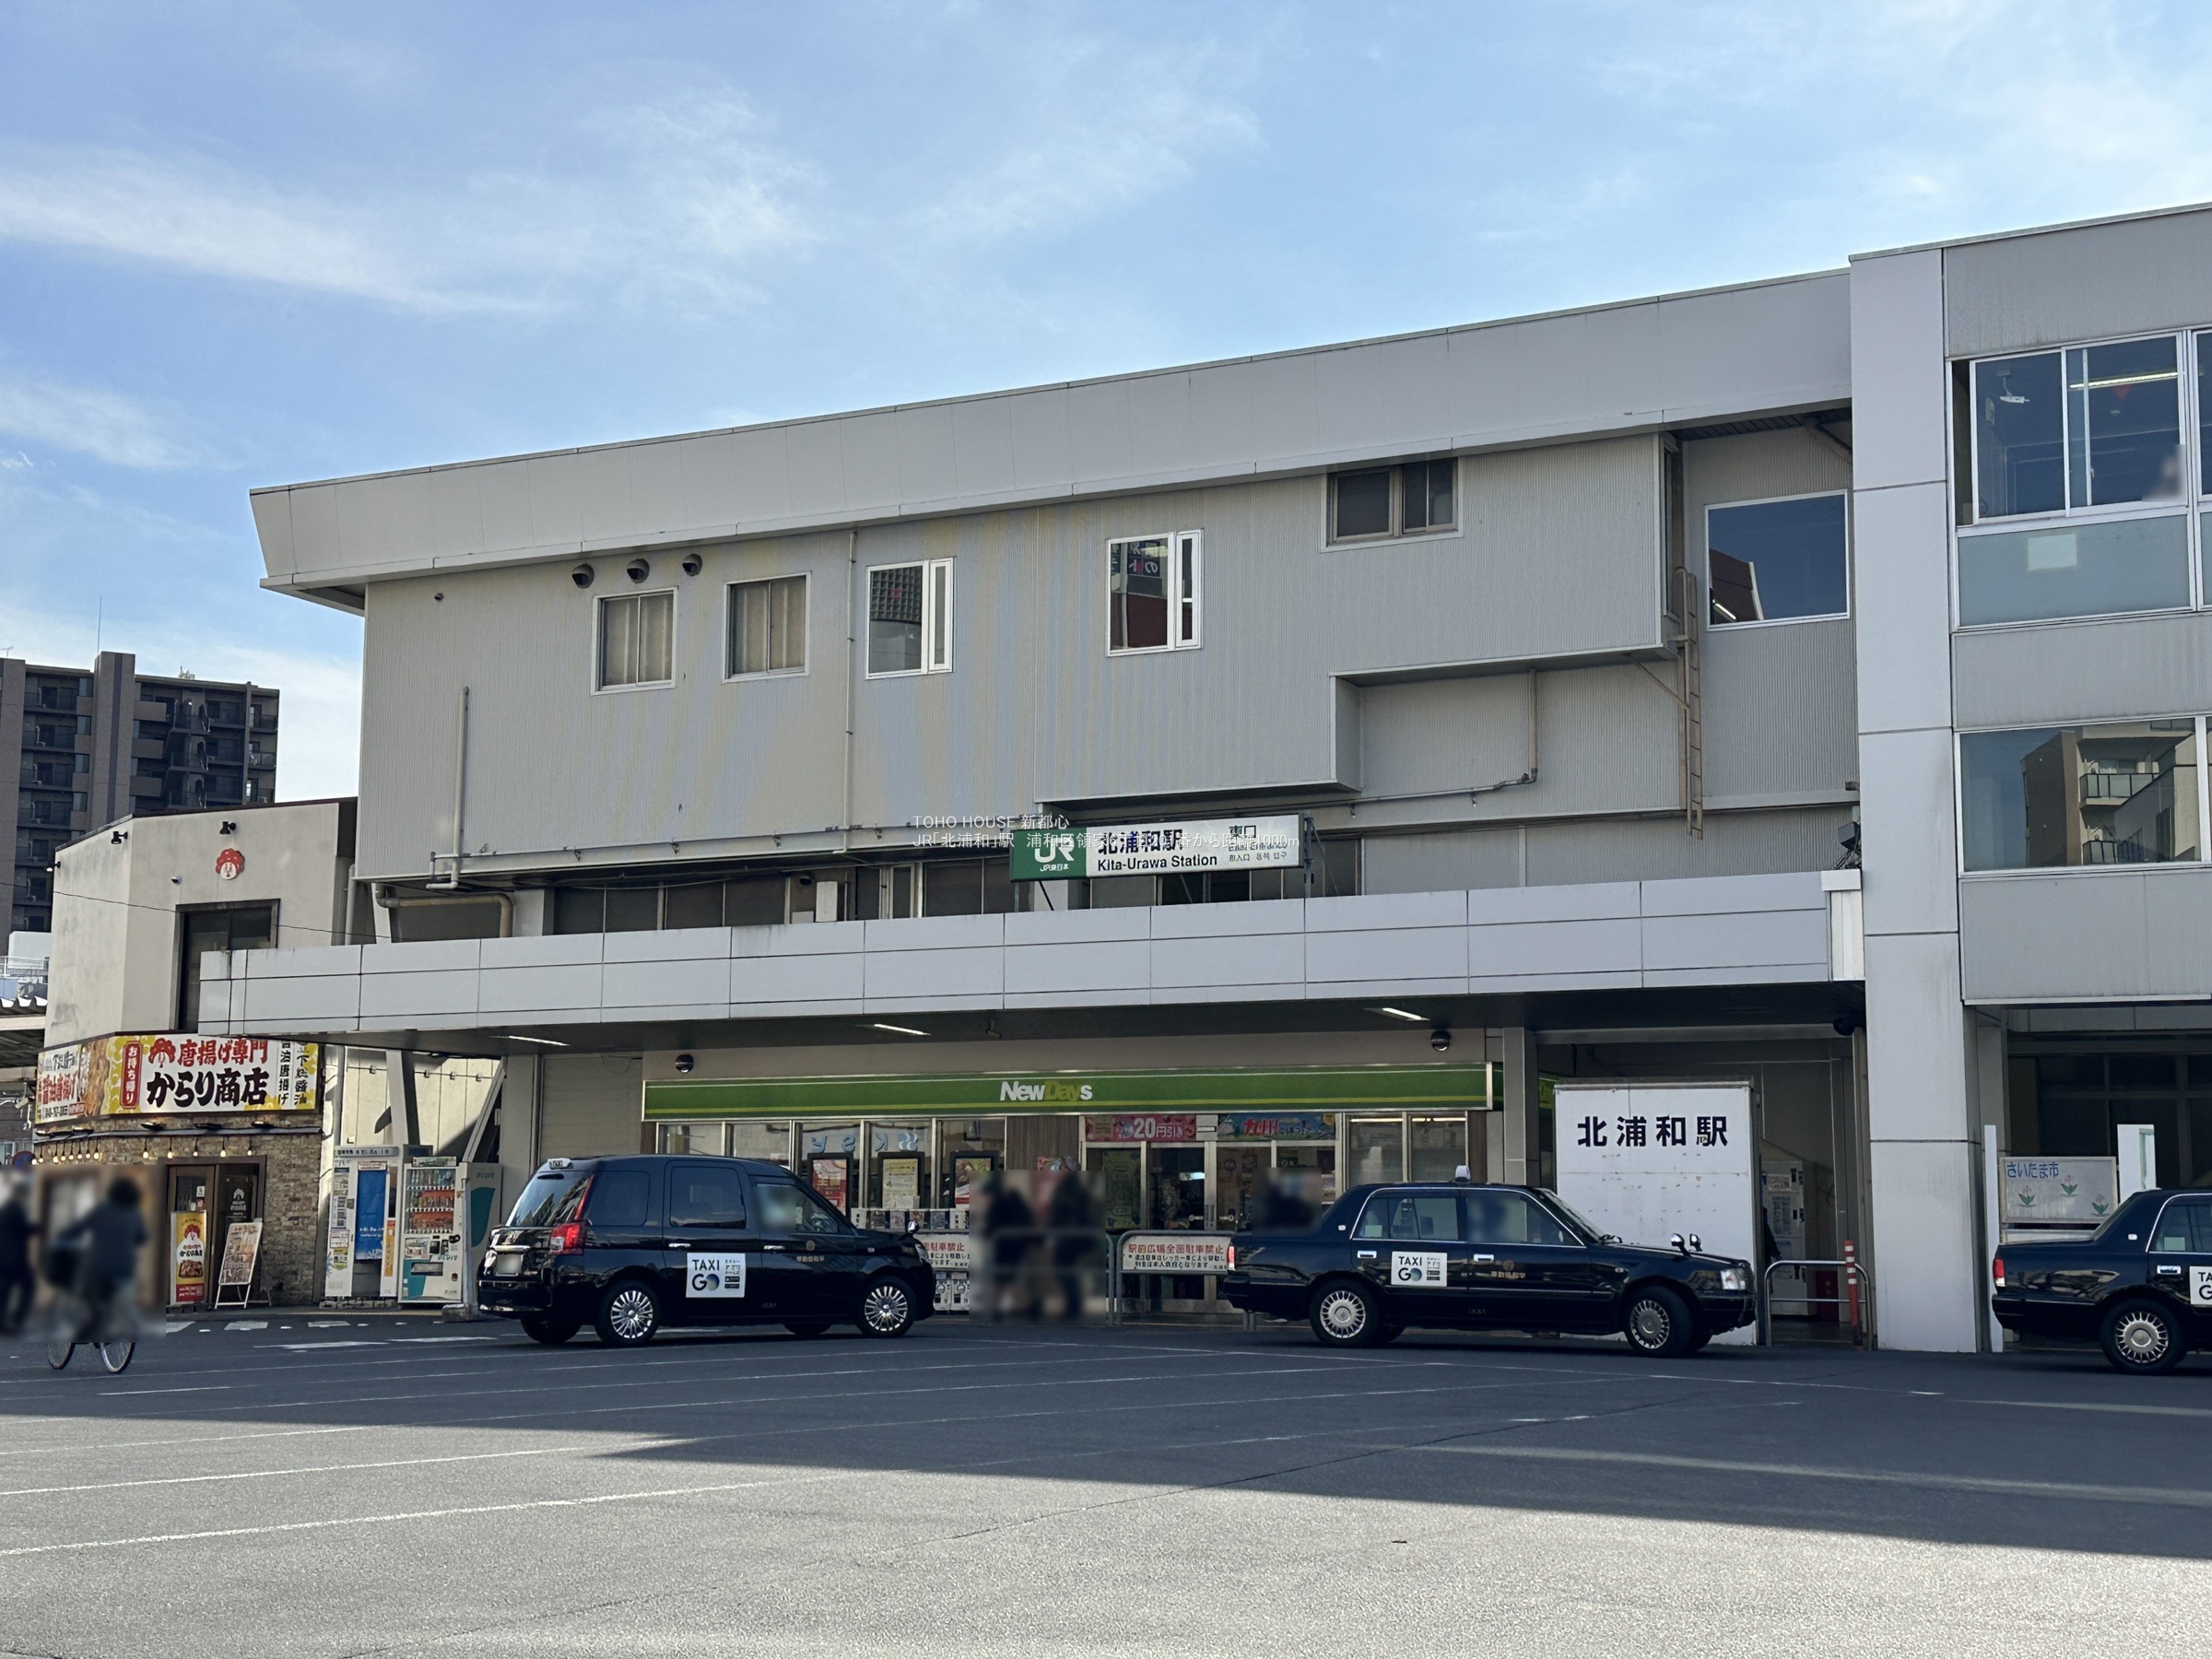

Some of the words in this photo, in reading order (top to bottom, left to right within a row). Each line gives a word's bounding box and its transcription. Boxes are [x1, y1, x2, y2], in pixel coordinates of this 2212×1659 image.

[1034, 837, 1075, 863] JR
[1098, 829, 1183, 855] 北浦和駅
[1098, 857, 1167, 871] Kita-Urawa
[1171, 854, 1218, 867] Station
[178, 1038, 268, 1067] 唐揚げ専門
[125, 1045, 138, 1104] お持ち帰り
[147, 1067, 270, 1108] からり商店
[1000, 1080, 1093, 1102] NewDays
[1577, 1115, 1728, 1147] 北浦和駅
[2006, 1161, 2059, 1179] さいたま市
[692, 1259, 720, 1271] TAXI
[1398, 1256, 1422, 1266] TAXI
